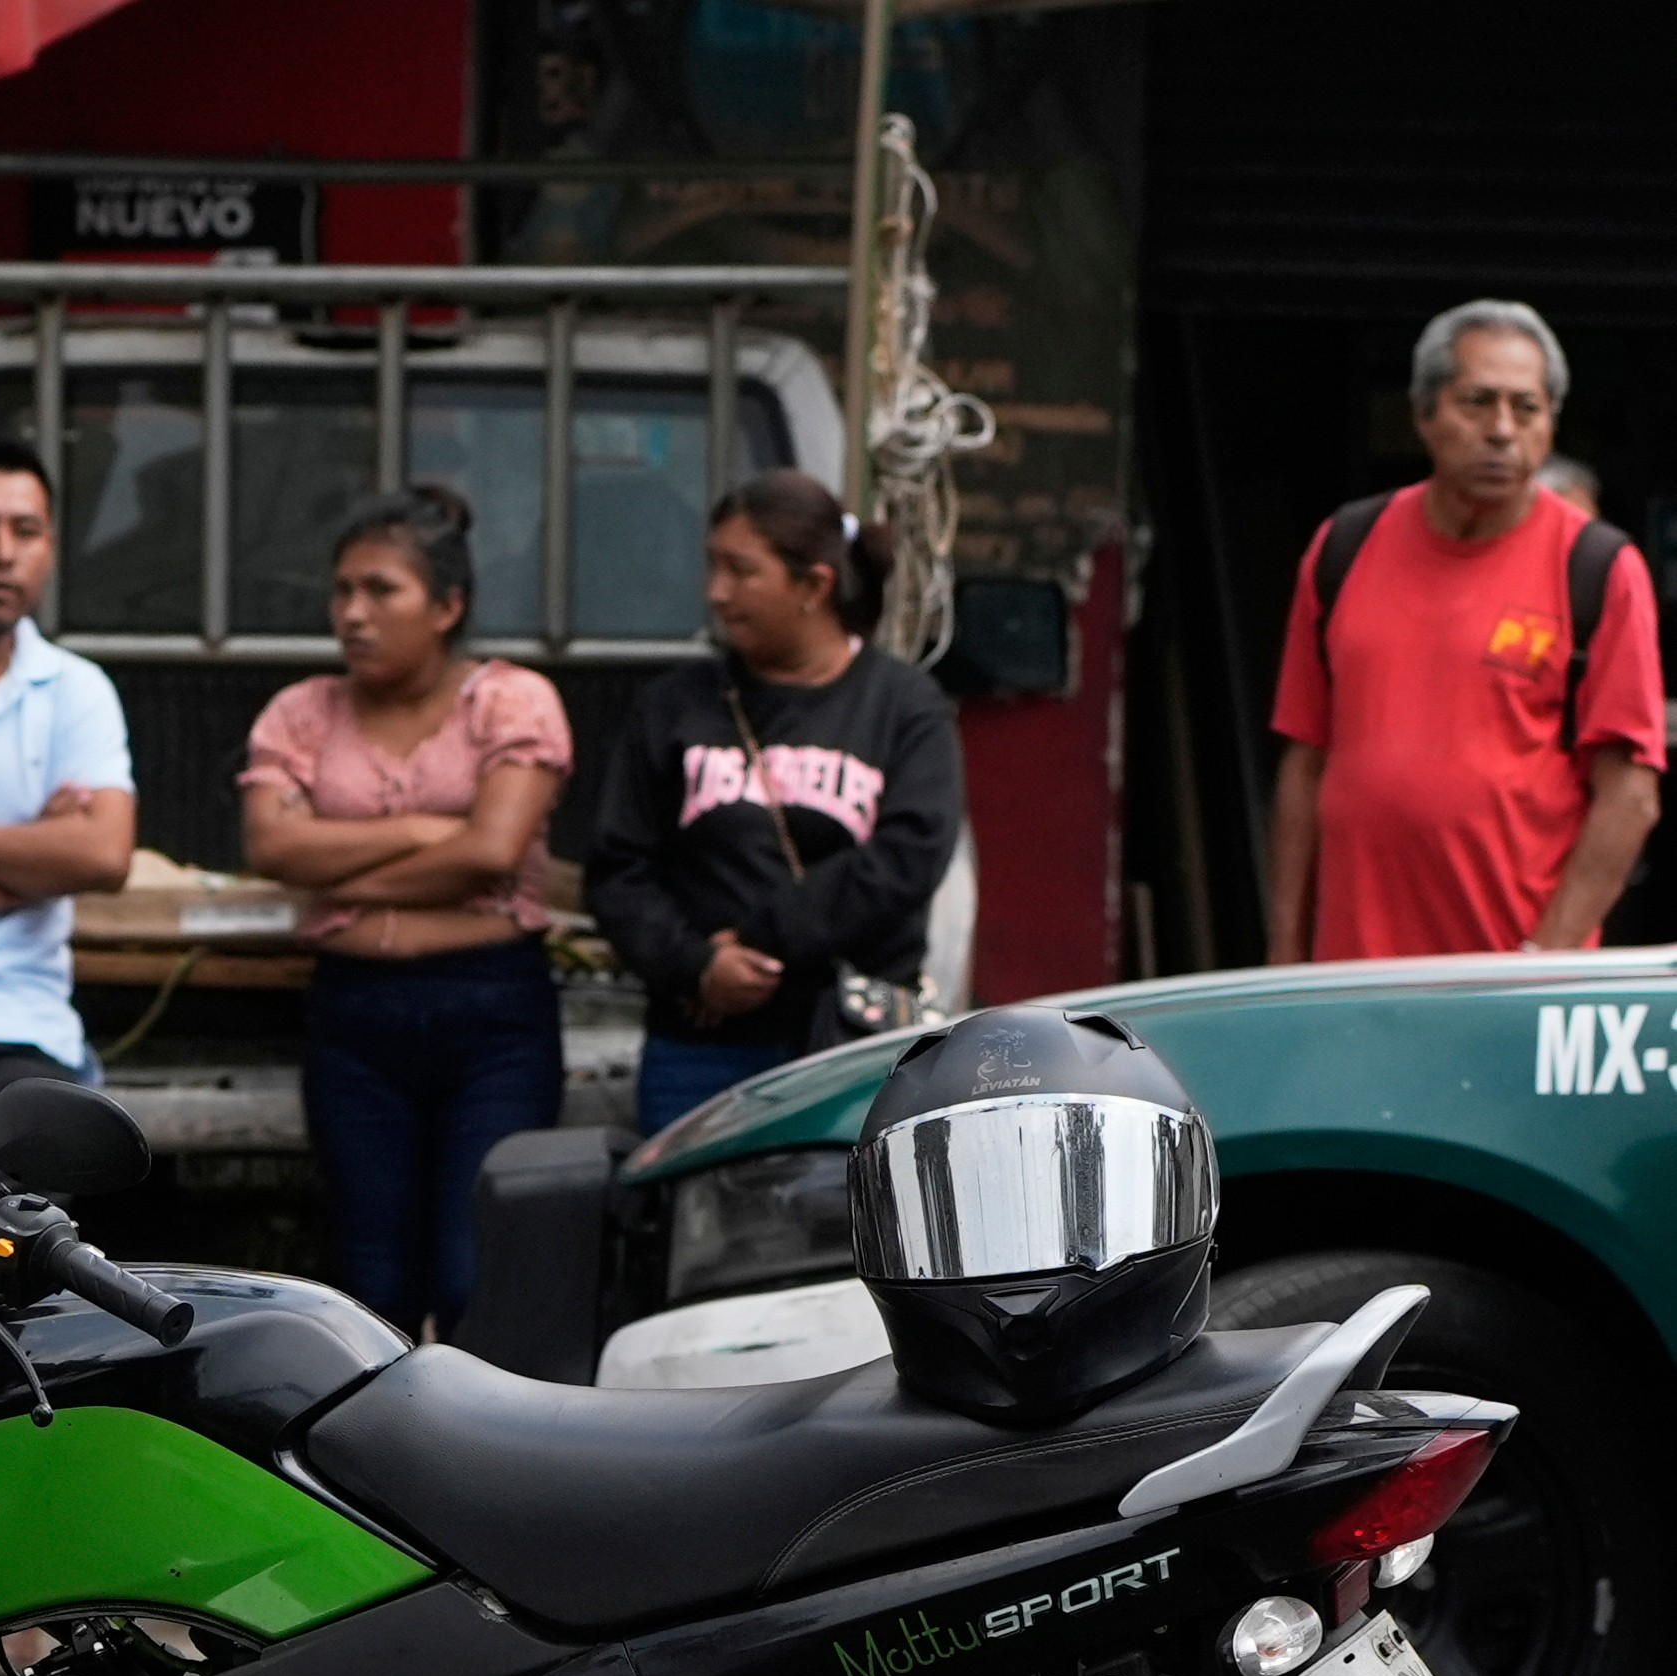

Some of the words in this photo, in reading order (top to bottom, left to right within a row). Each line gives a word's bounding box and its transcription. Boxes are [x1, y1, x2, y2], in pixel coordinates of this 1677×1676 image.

[73, 194, 255, 240] NUEVO
[1535, 1003, 1677, 1096] MX-
[971, 1074, 1041, 1096] LEVIATÁN
[983, 1547, 1181, 1639] SPORT
